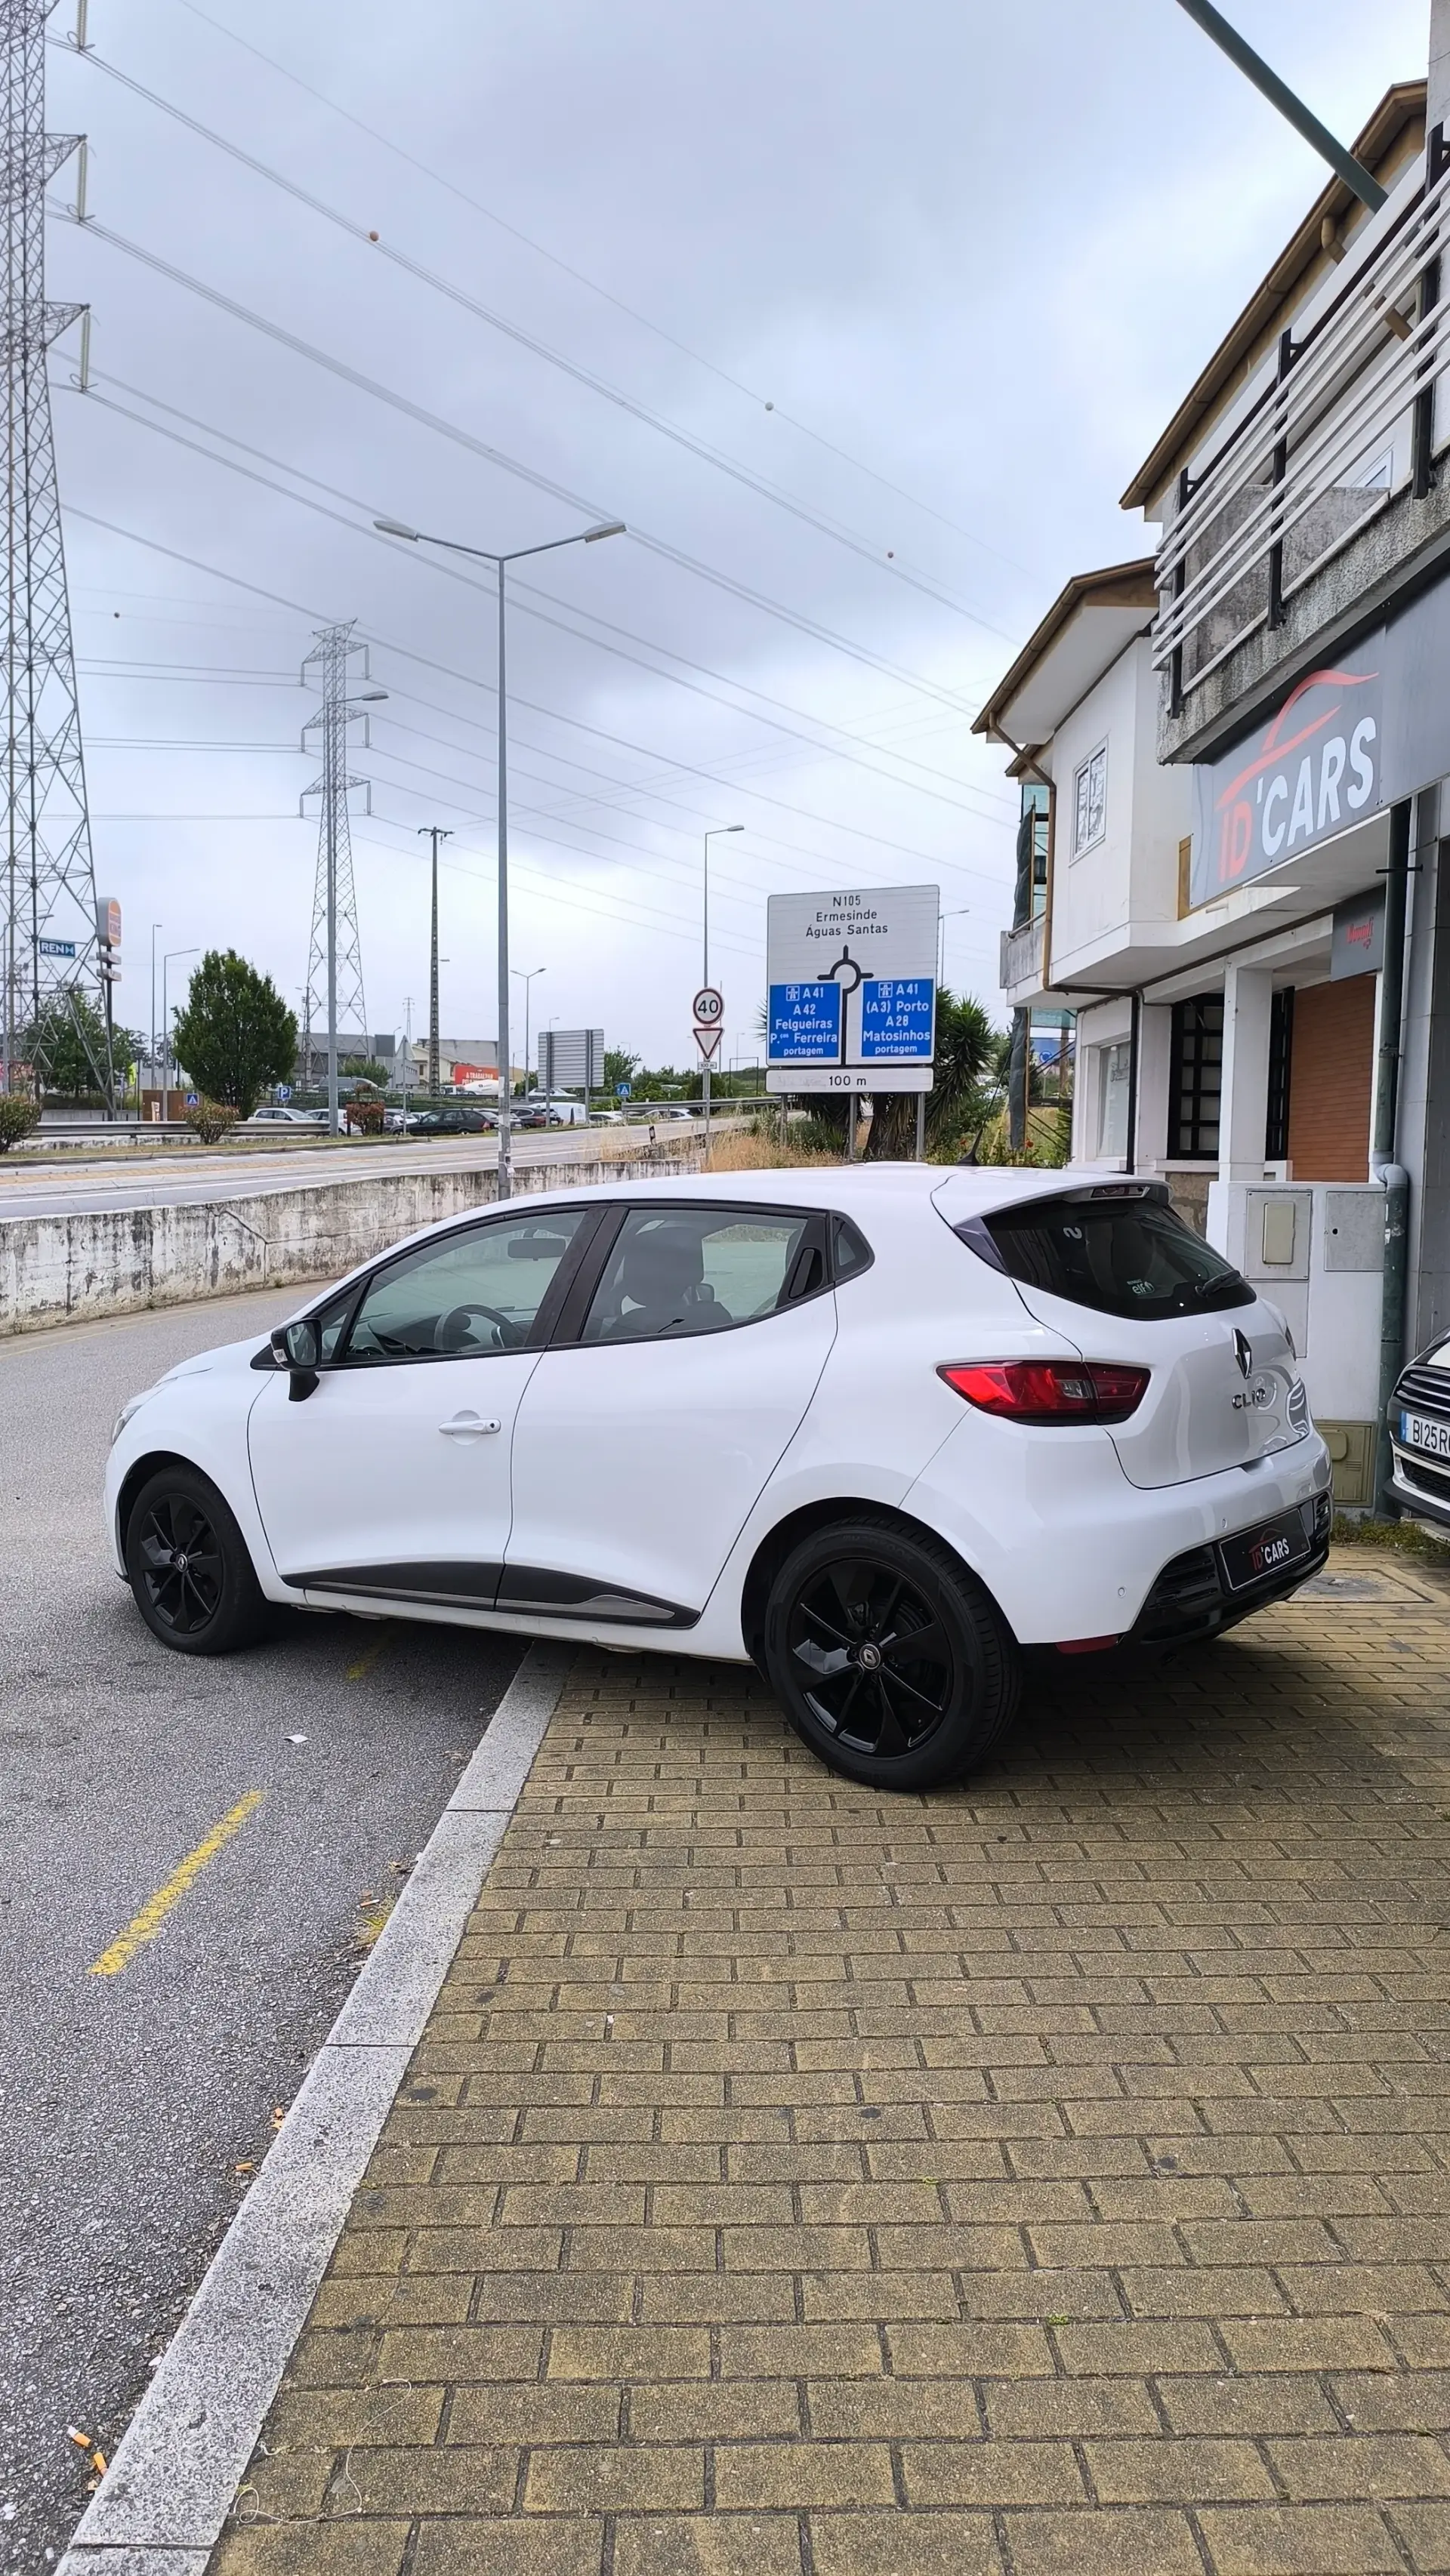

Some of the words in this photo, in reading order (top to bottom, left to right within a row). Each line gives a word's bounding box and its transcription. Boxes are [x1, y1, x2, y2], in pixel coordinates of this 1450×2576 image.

[816, 909, 878, 922] Ermesinde
[806, 924, 841, 938] Águas
[847, 923, 888, 935] Santas
[41, 942, 64, 954] REN
[698, 1000, 718, 1013] 40
[896, 1000, 929, 1012] Porto
[776, 1018, 833, 1031] Felgueiras
[794, 1031, 837, 1043] Ferreira
[863, 1030, 930, 1042] Matosinhos
[783, 1046, 823, 1056] portagem
[875, 1045, 918, 1055] portagem
[829, 1076, 850, 1086] 100
[1132, 1283, 1146, 1294] elf
[1232, 1388, 1266, 1410] CLIO
